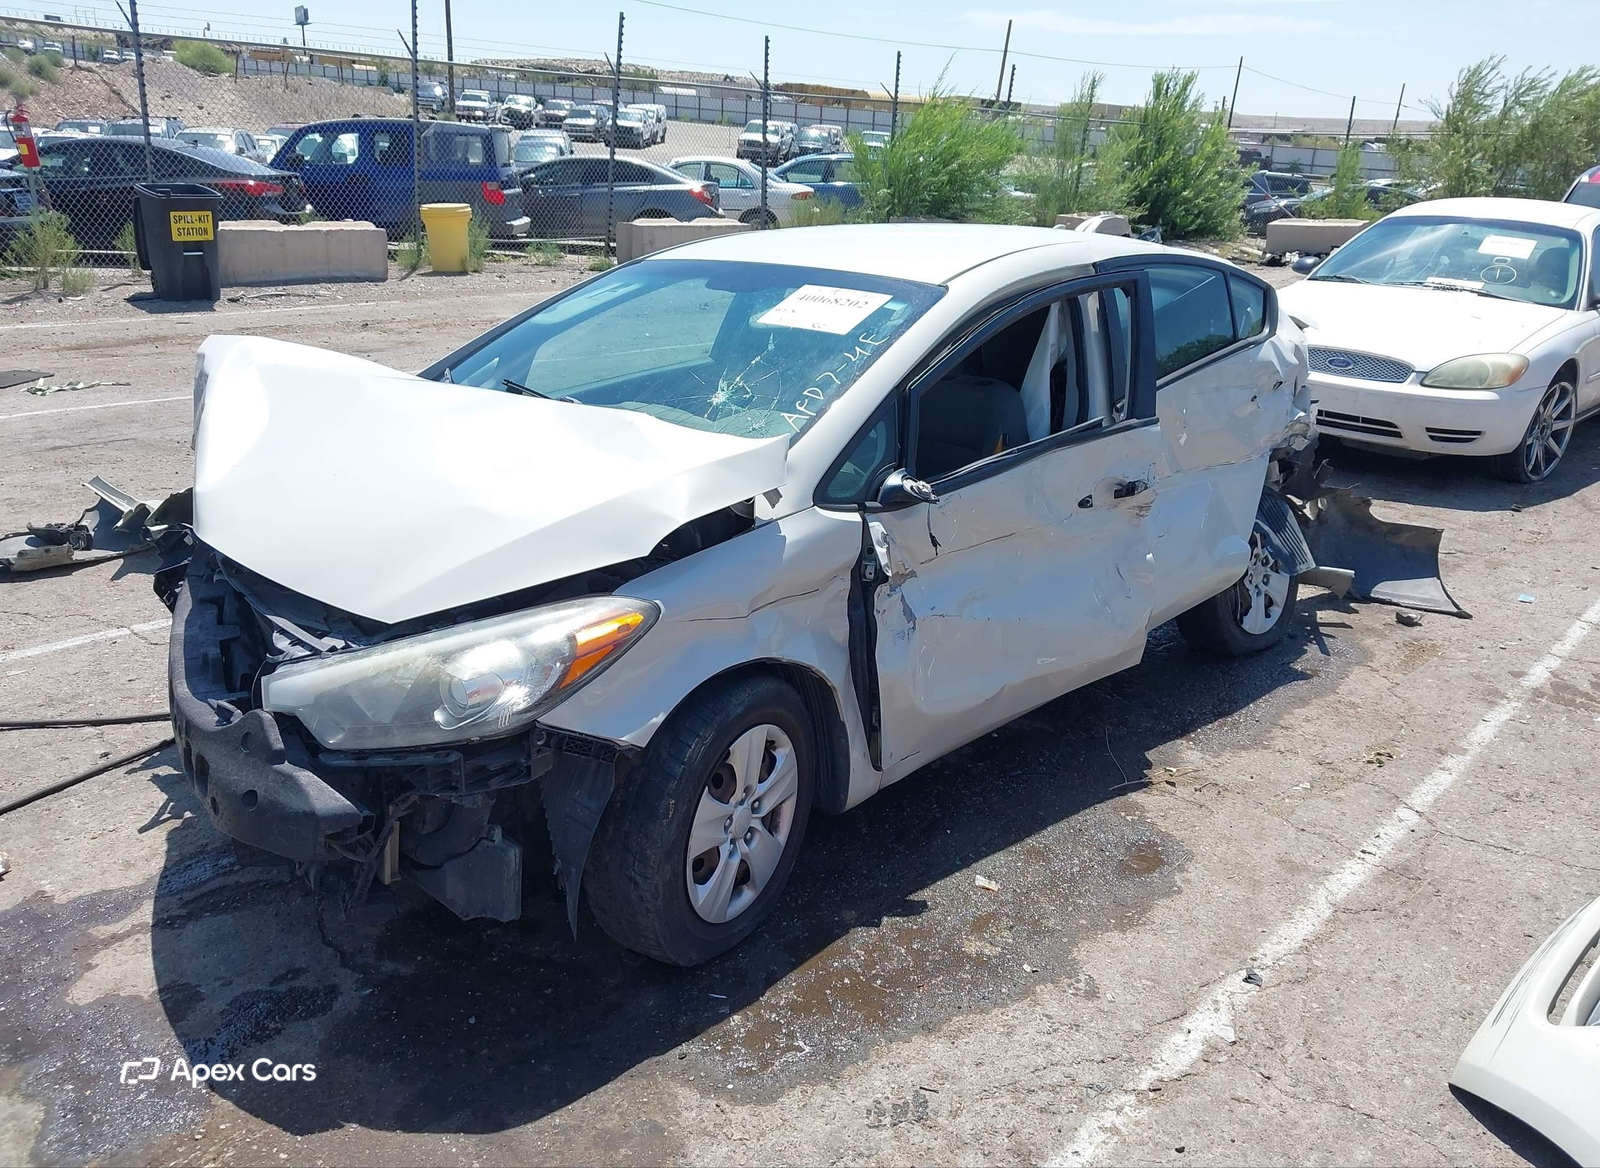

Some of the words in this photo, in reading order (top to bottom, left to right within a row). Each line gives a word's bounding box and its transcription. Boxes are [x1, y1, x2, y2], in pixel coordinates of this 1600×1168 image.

[172, 214, 210, 224] SPILL-KIT
[176, 227, 209, 237] STATION
[797, 293, 870, 309] 40068202
